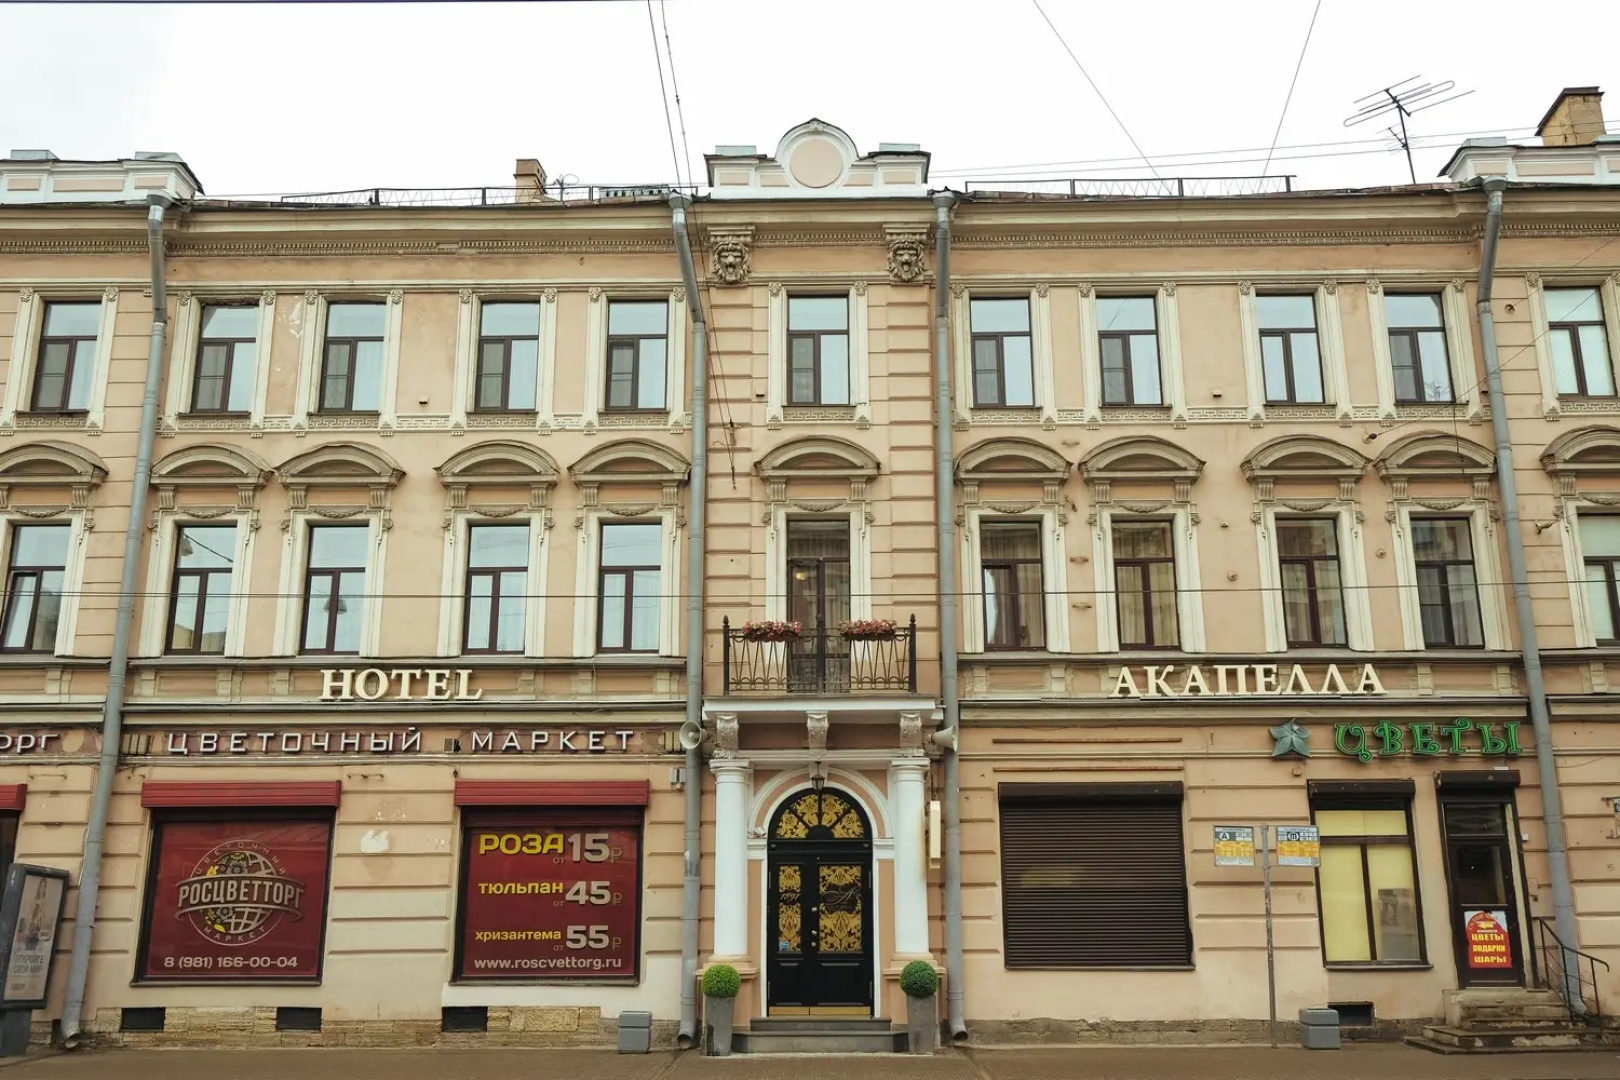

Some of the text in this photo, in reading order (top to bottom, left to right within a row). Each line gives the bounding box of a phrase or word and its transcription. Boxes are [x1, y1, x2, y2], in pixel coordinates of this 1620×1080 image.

[318, 668, 483, 700] HOTEL
[1108, 663, 1389, 698] АКАПЕЛЛА
[167, 727, 634, 754] ЦВЕТОЧНЫЙ МАРКЕТ
[1335, 717, 1523, 763] ЦВЕТЫ
[479, 833, 564, 855] РОЗА
[567, 833, 610, 862] 15
[178, 880, 305, 908] РОСЦВЕТТОРГ
[478, 882, 564, 894] тюльпан
[565, 880, 611, 905] 45
[203, 926, 265, 942] МАРКЕТ
[475, 931, 562, 942] хризантема
[565, 925, 610, 949] 55
[1471, 933, 1504, 941] ЦВЕТЫ
[1472, 944, 1505, 952] ПОДАРКИ
[164, 956, 298, 969] 8 (981) 166-00-04
[474, 957, 622, 970] www.roscvettorg.ru
